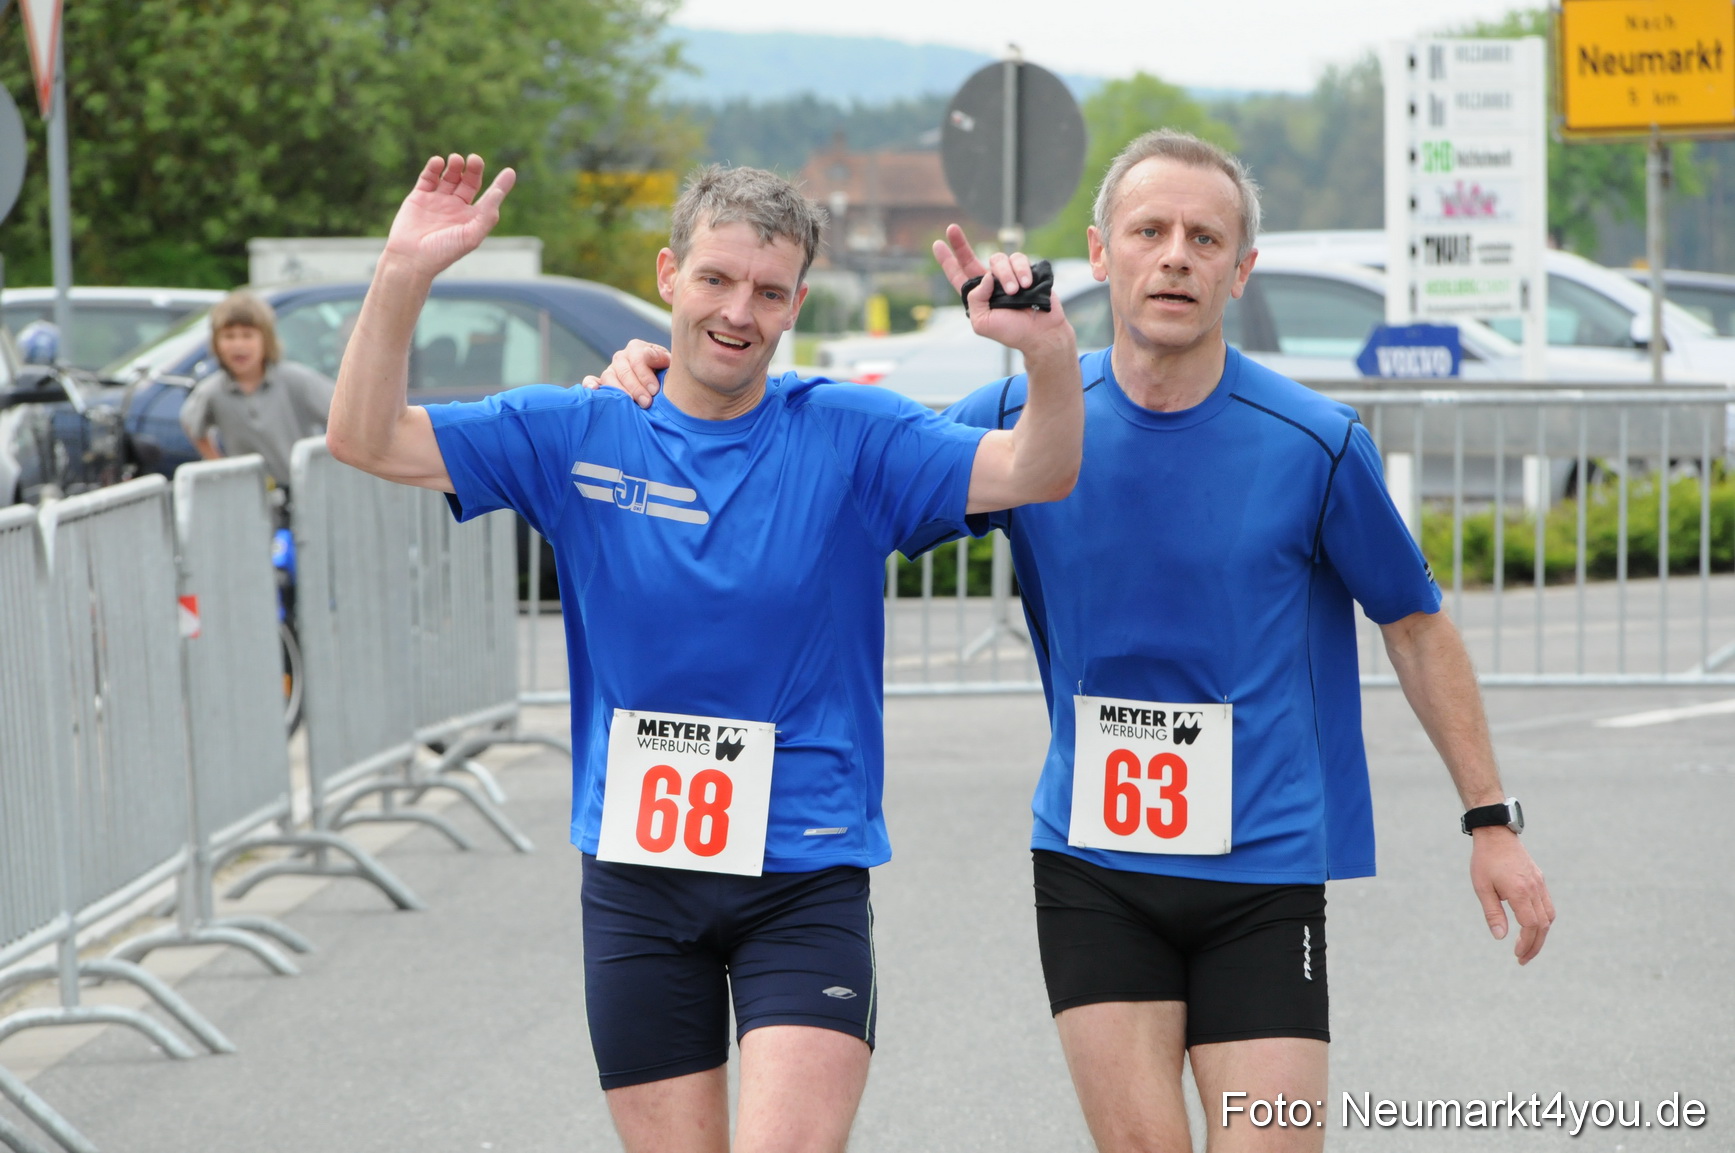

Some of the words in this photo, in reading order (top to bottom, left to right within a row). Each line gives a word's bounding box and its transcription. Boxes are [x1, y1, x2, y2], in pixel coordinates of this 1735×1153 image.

[1626, 13, 1676, 31] Nach
[1578, 38, 1723, 76] Neumarkt
[1653, 89, 1680, 105] km
[1376, 346, 1453, 377] VOLVO
[1100, 704, 1167, 728] MEYER
[637, 718, 712, 742] MEYER
[1100, 722, 1168, 741] WERBUNG
[637, 736, 711, 756] WERBUNG
[1103, 748, 1188, 839] 63
[635, 764, 734, 857] 68
